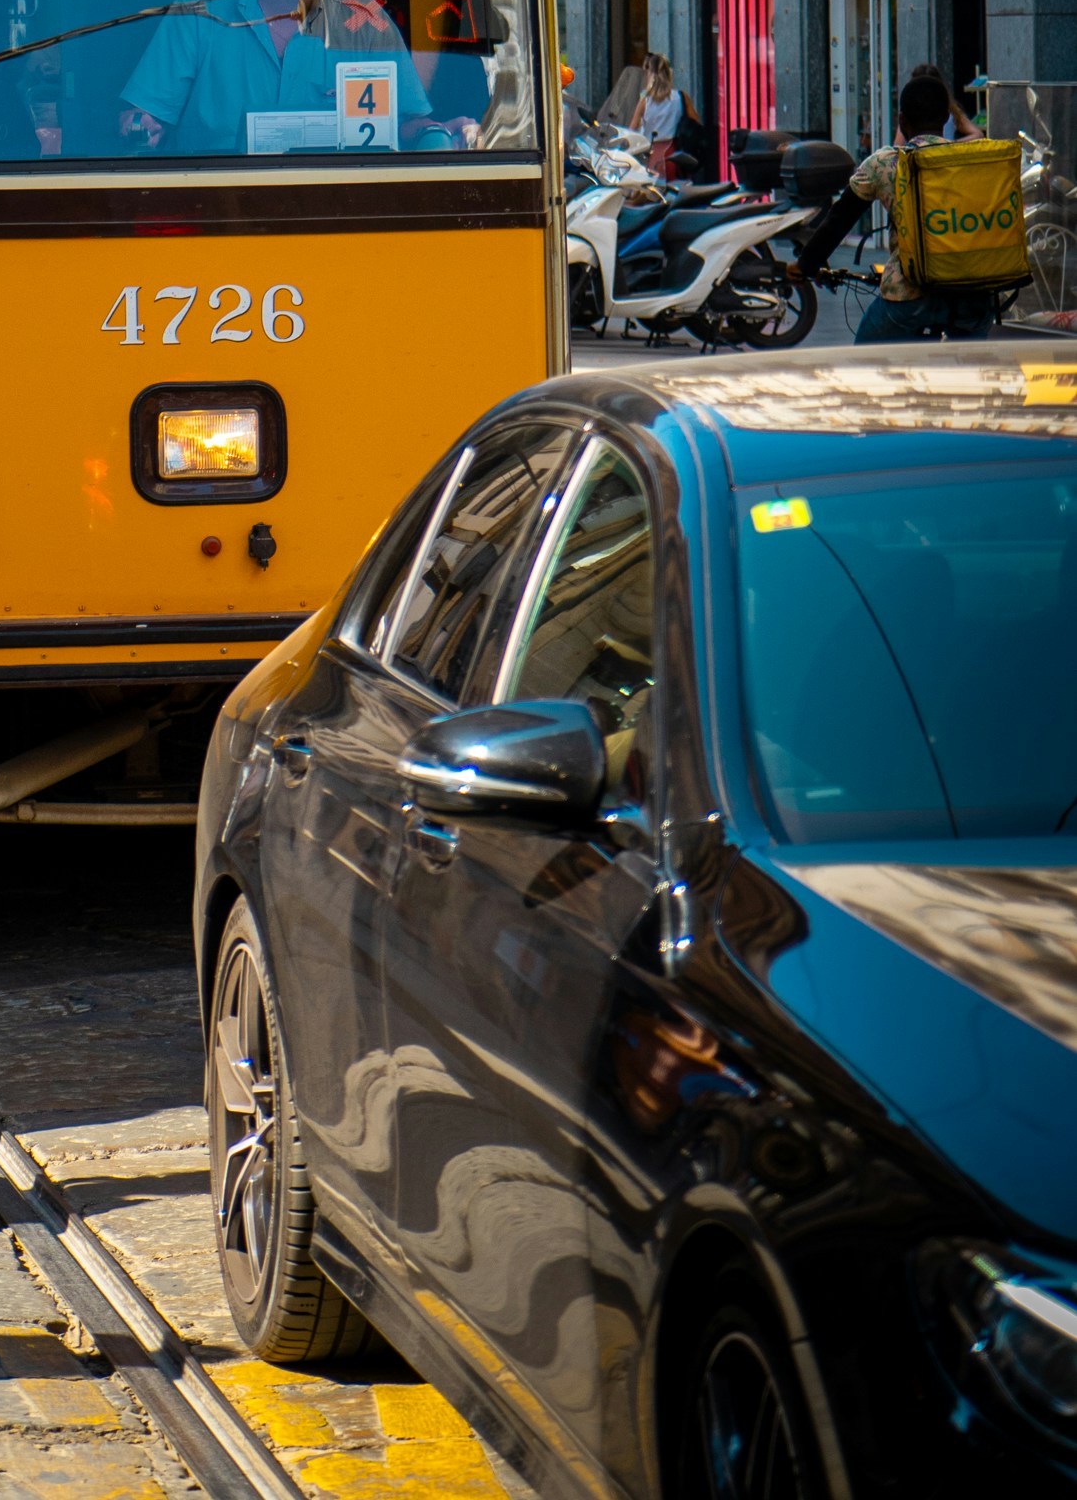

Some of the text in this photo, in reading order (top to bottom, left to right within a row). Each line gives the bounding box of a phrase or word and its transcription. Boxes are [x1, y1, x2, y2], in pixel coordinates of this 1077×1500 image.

[357, 82, 376, 115] 4
[359, 122, 376, 147] 2
[925, 207, 1014, 235] Glovo
[100, 284, 305, 345] 4726
